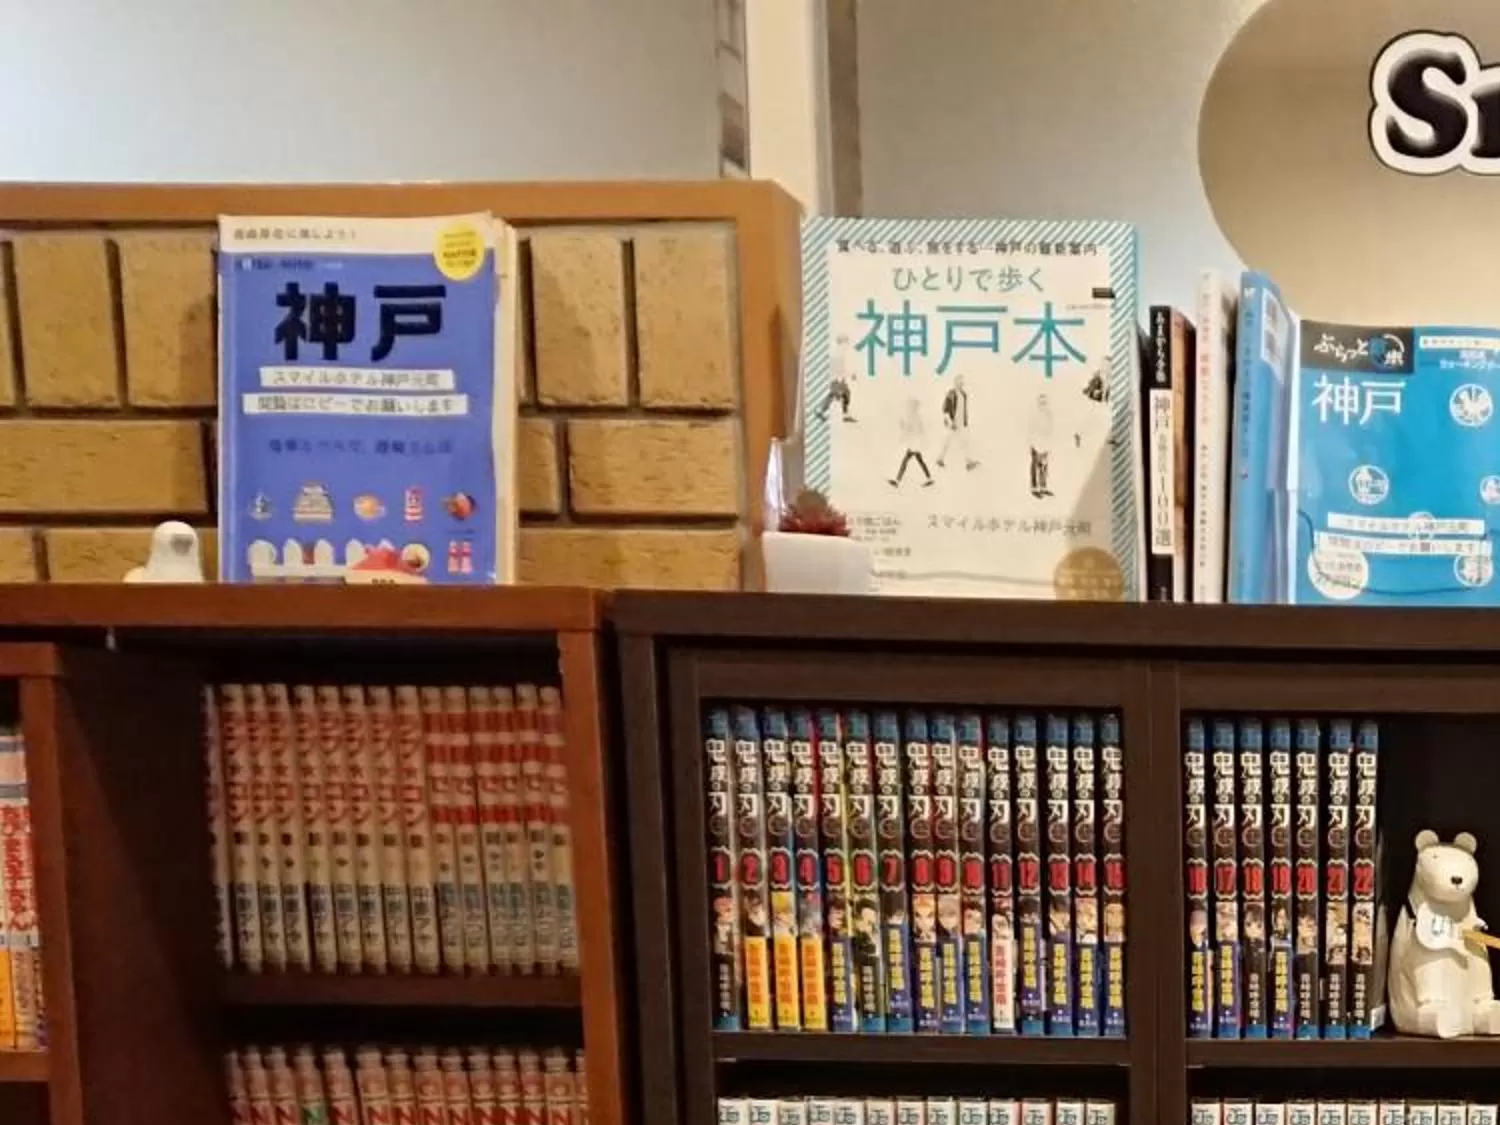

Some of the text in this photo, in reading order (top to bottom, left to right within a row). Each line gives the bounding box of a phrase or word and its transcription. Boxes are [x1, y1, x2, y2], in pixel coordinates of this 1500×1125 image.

[893, 265, 1044, 292] ひとりで歩く
[274, 281, 447, 362] 神戸
[855, 299, 1087, 378] 神戸本
[1311, 373, 1407, 426] 神戸
